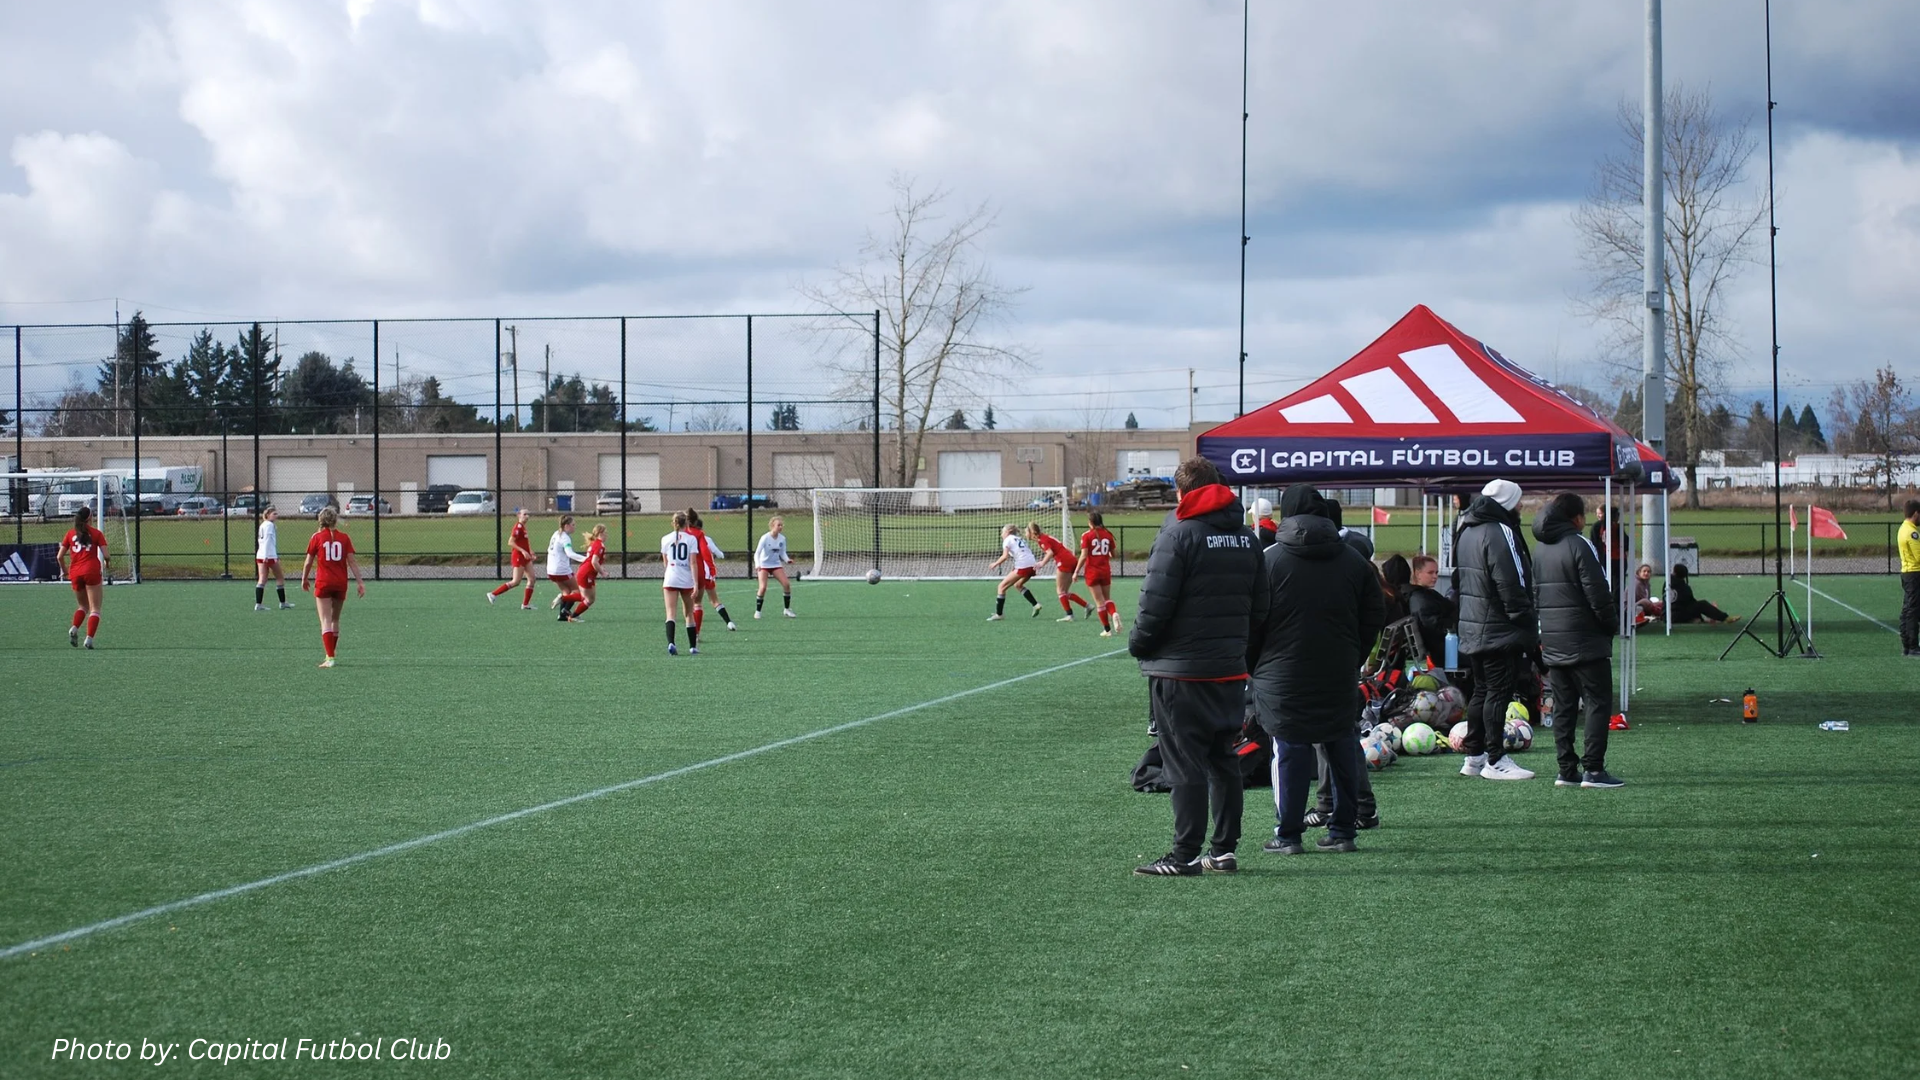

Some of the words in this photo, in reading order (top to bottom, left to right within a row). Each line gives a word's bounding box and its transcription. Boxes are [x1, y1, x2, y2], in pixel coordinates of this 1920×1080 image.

[1271, 450, 1384, 468] CAPITAL
[1392, 443, 1498, 466] FÚTBOL
[1504, 450, 1575, 467] CLUB
[323, 541, 342, 562] 10
[670, 542, 688, 561] 10
[1091, 538, 1110, 556] 26
[1206, 535, 1240, 549] CAPITAL
[1240, 535, 1251, 549] FC
